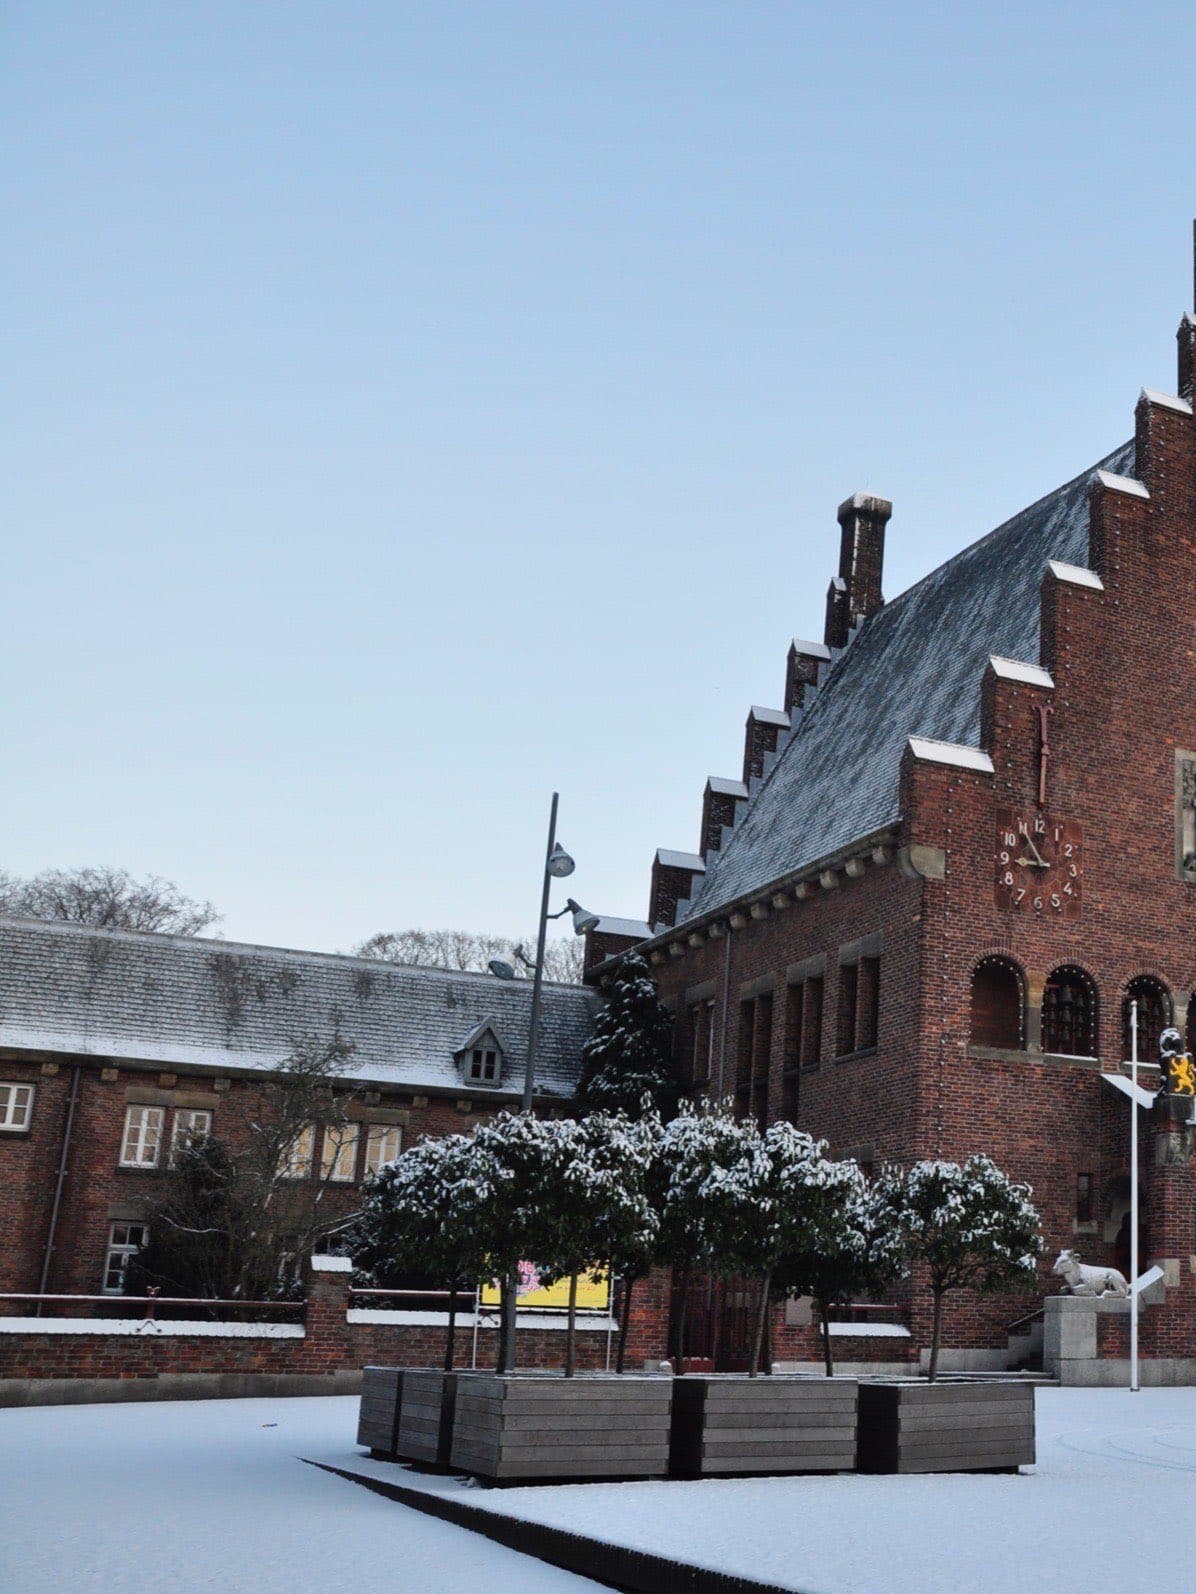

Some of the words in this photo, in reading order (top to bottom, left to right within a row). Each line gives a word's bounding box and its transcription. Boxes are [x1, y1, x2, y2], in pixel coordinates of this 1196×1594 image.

[1035, 819, 1045, 833] 12
[1005, 832, 1016, 846] 10
[1055, 828, 1058, 841] 1
[1065, 844, 1072, 857] 2
[1000, 852, 1009, 865] 9
[1069, 864, 1077, 877] 3
[1005, 871, 1013, 885] 8
[1017, 888, 1025, 901] 7
[1063, 882, 1072, 895] 4
[1034, 896, 1042, 909] 6
[1052, 894, 1060, 907] 5
